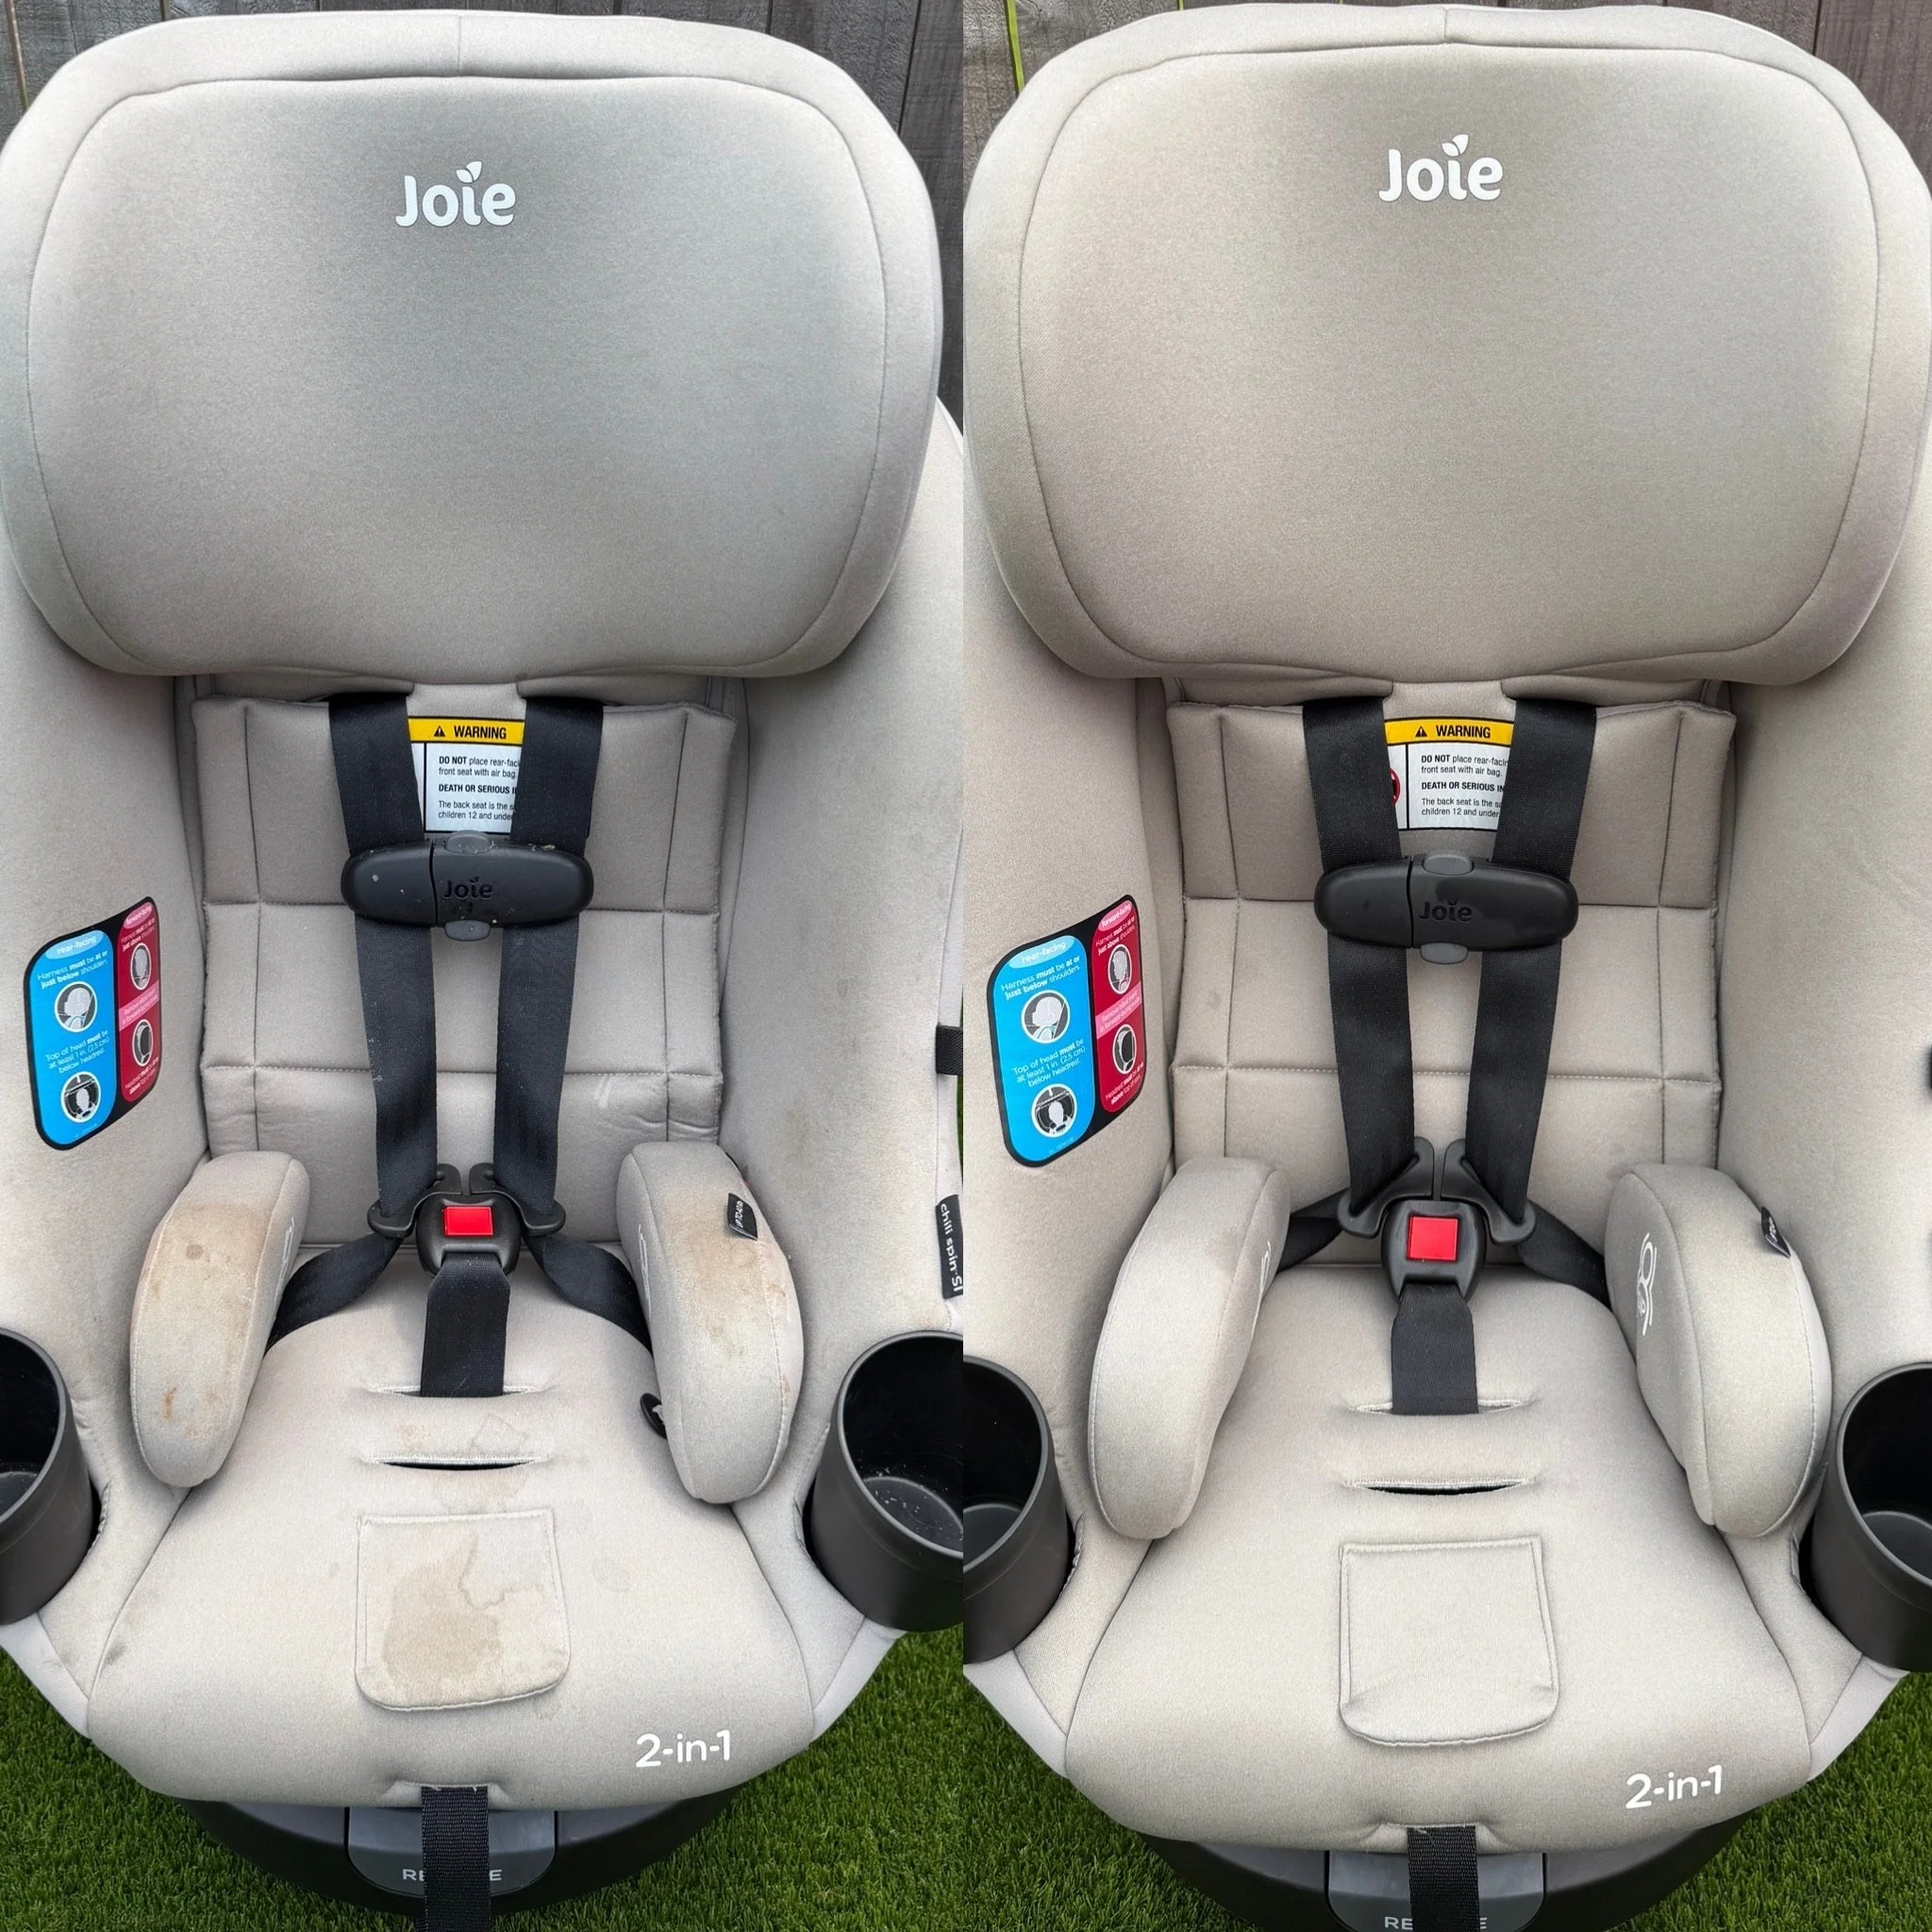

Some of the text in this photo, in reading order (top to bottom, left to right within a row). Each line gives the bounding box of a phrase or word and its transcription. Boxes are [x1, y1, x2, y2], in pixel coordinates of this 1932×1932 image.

[1379, 134, 1503, 201] Joie
[395, 161, 516, 226] Joie
[453, 724, 508, 740] WARNING
[1436, 724, 1491, 740] WARNING
[469, 757, 489, 766] place
[1453, 755, 1472, 764] place
[438, 766, 455, 775] front
[458, 768, 472, 776] seat
[474, 768, 489, 776] with
[491, 769, 500, 777] air
[1421, 765, 1438, 774] front
[1475, 766, 1485, 774] air
[1487, 768, 1502, 777] bag.
[438, 784, 463, 792] DEATH
[477, 785, 509, 794] SERIOUS
[1421, 781, 1447, 790] DEATH
[1461, 782, 1494, 792] SERIOUS
[438, 800, 451, 808] The
[453, 800, 470, 809] back
[496, 802, 508, 810] the
[1481, 799, 1492, 808] the
[479, 811, 491, 820] and
[443, 875, 492, 898] Joie
[1101, 904, 1131, 928] forward-facing
[1419, 898, 1473, 923] Joie
[57, 936, 96, 956] rear-facing
[1022, 941, 1066, 962] rear-facing
[38, 966, 68, 981] Harness
[69, 958, 87, 970] must
[87, 956, 94, 964] be
[1001, 975, 1036, 991] Harness
[1036, 966, 1056, 979] must
[1056, 962, 1065, 972] be
[41, 977, 57, 990] just
[57, 970, 79, 983] below
[1005, 990, 1023, 1000] just
[1023, 978, 1048, 993] below
[45, 1053, 60, 1062] Top
[60, 1047, 68, 1056] of
[70, 1040, 87, 1053] head
[1011, 1038, 1085, 1075] Top of head must be
[49, 1060, 57, 1070] at
[58, 1055, 75, 1065] least
[58, 1061, 79, 1074] below
[1017, 1074, 1026, 1083] at
[1026, 1066, 1045, 1079] least
[1027, 1074, 1051, 1087] below
[941, 1204, 953, 1235] chili
[636, 1730, 730, 1768] 2-in-1
[1625, 1764, 1723, 1809] 2-in-1
